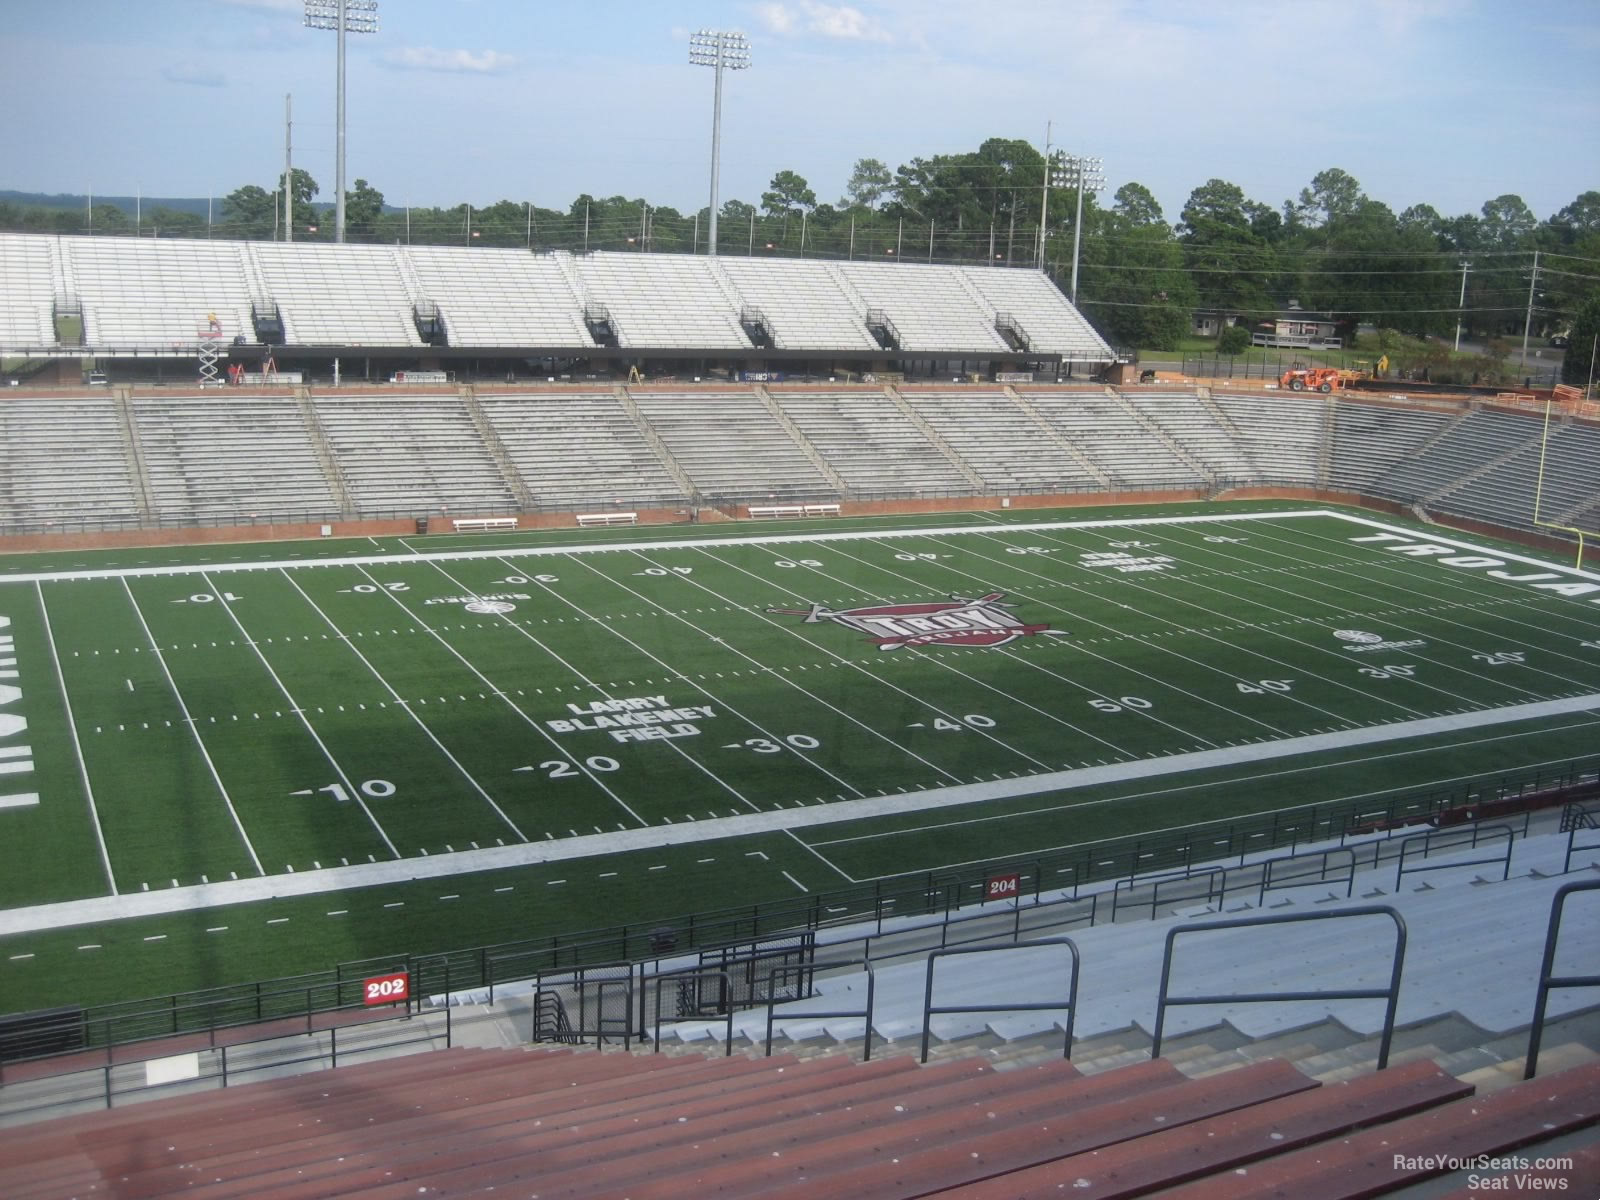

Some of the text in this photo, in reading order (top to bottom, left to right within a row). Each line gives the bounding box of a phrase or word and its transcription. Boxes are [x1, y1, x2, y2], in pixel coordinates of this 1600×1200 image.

[895, 552, 937, 561] 40
[1006, 546, 1050, 554] 30
[644, 566, 693, 576] 40
[774, 559, 824, 568] 50
[505, 574, 560, 584] 30
[353, 582, 411, 593] 20
[190, 592, 244, 603] 10
[863, 609, 1004, 636] TROY
[907, 630, 1024, 644] TROJANS
[1472, 652, 1525, 665] 20
[1358, 664, 1415, 678] 30
[1236, 679, 1291, 695] 40
[566, 695, 670, 715] LARRY
[1087, 696, 1152, 713] 50
[546, 705, 718, 733] BLAKENEY
[933, 714, 997, 731] 40
[608, 723, 701, 743] FIELD
[745, 734, 820, 753] 30
[539, 756, 621, 778] 20
[319, 779, 397, 801] 10
[990, 879, 1016, 894] 204
[367, 978, 405, 998] 202
